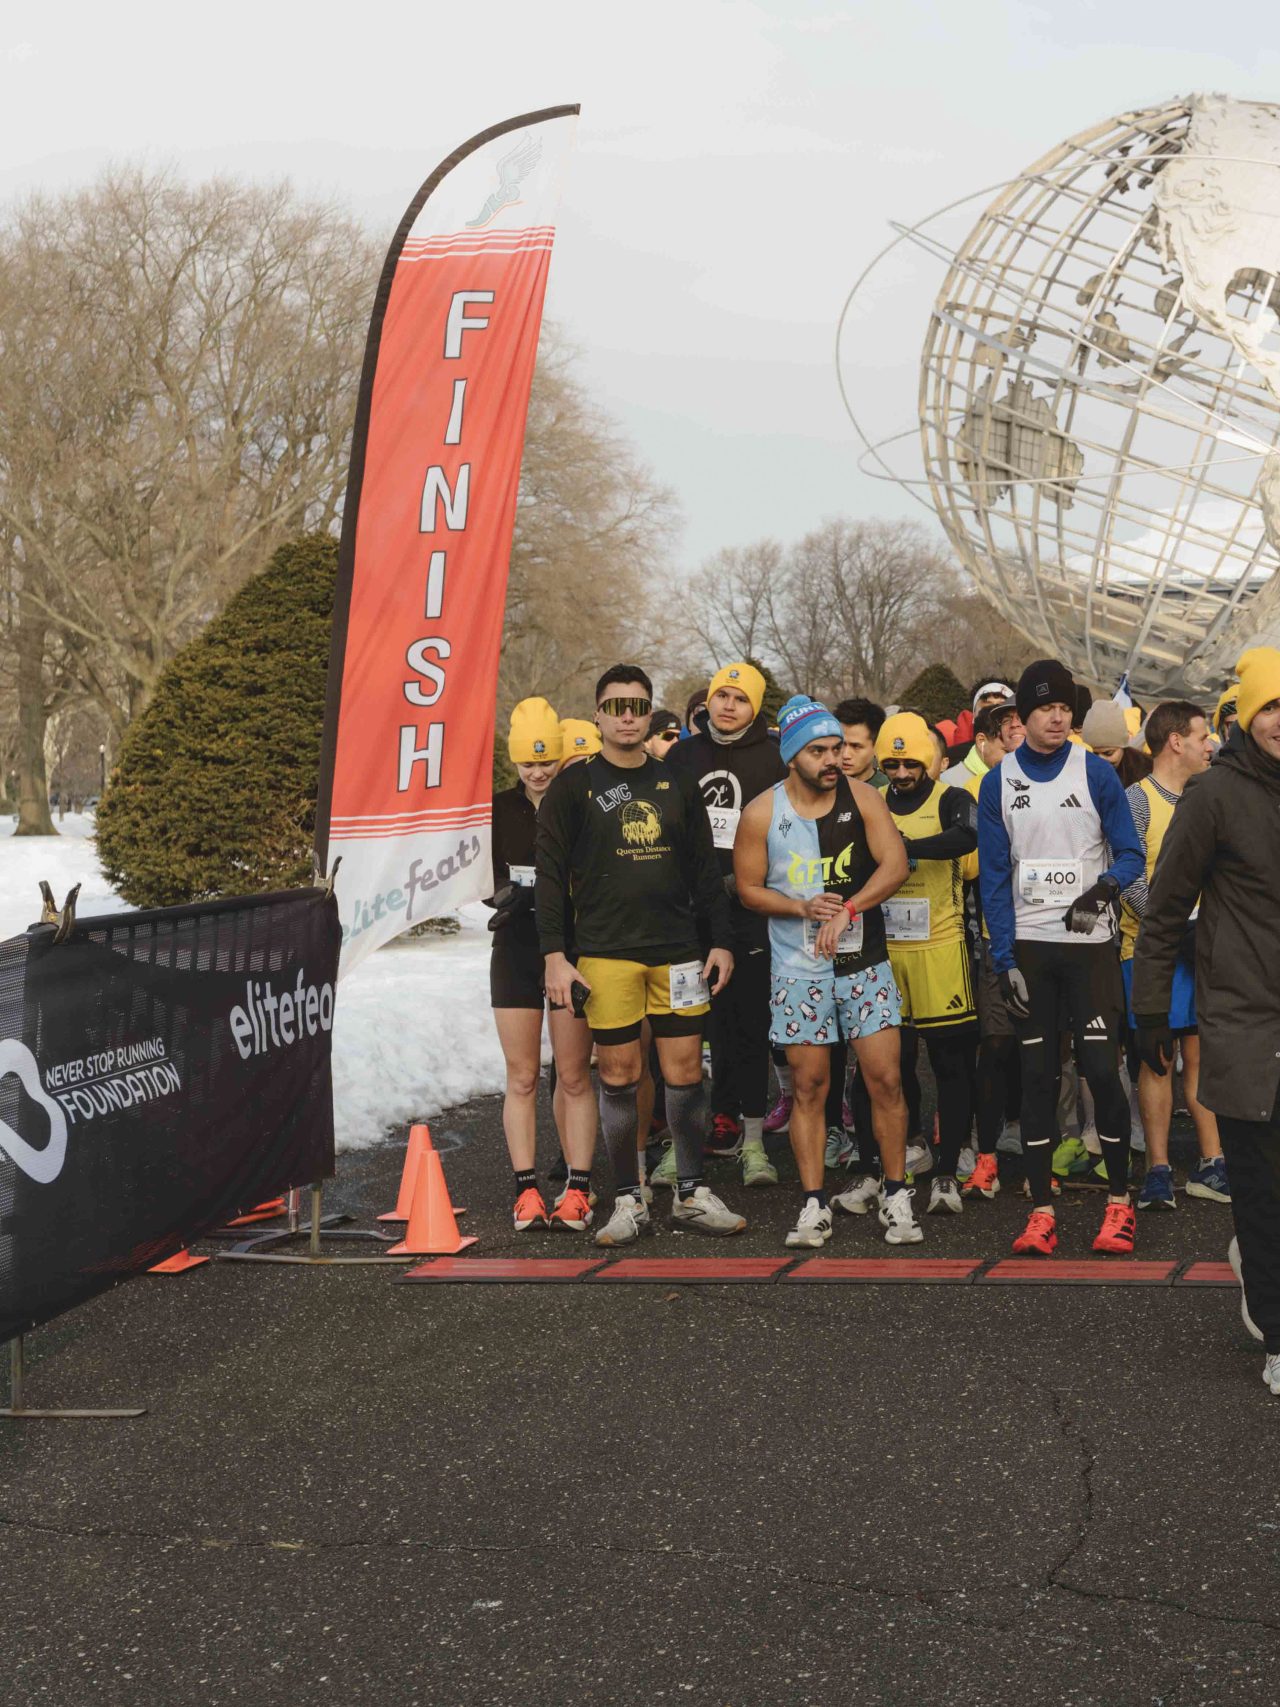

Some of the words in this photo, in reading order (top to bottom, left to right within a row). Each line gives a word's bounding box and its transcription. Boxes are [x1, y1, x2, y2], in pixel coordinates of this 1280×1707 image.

[396, 289, 496, 793] FINISH
[786, 706, 814, 724] RUN
[596, 783, 632, 812] LVC
[712, 817, 728, 830] 22
[616, 847, 645, 857] Queens
[632, 852, 662, 861] Runners
[787, 842, 854, 885] GFTC
[1044, 871, 1076, 885] 400
[906, 908, 911, 921] 1
[230, 968, 336, 1060] elitefea
[45, 1060, 85, 1089] NEVER
[86, 1051, 115, 1080] STOP
[116, 1037, 166, 1066] RUNNING
[57, 1062, 181, 1124] FOUNDATION
